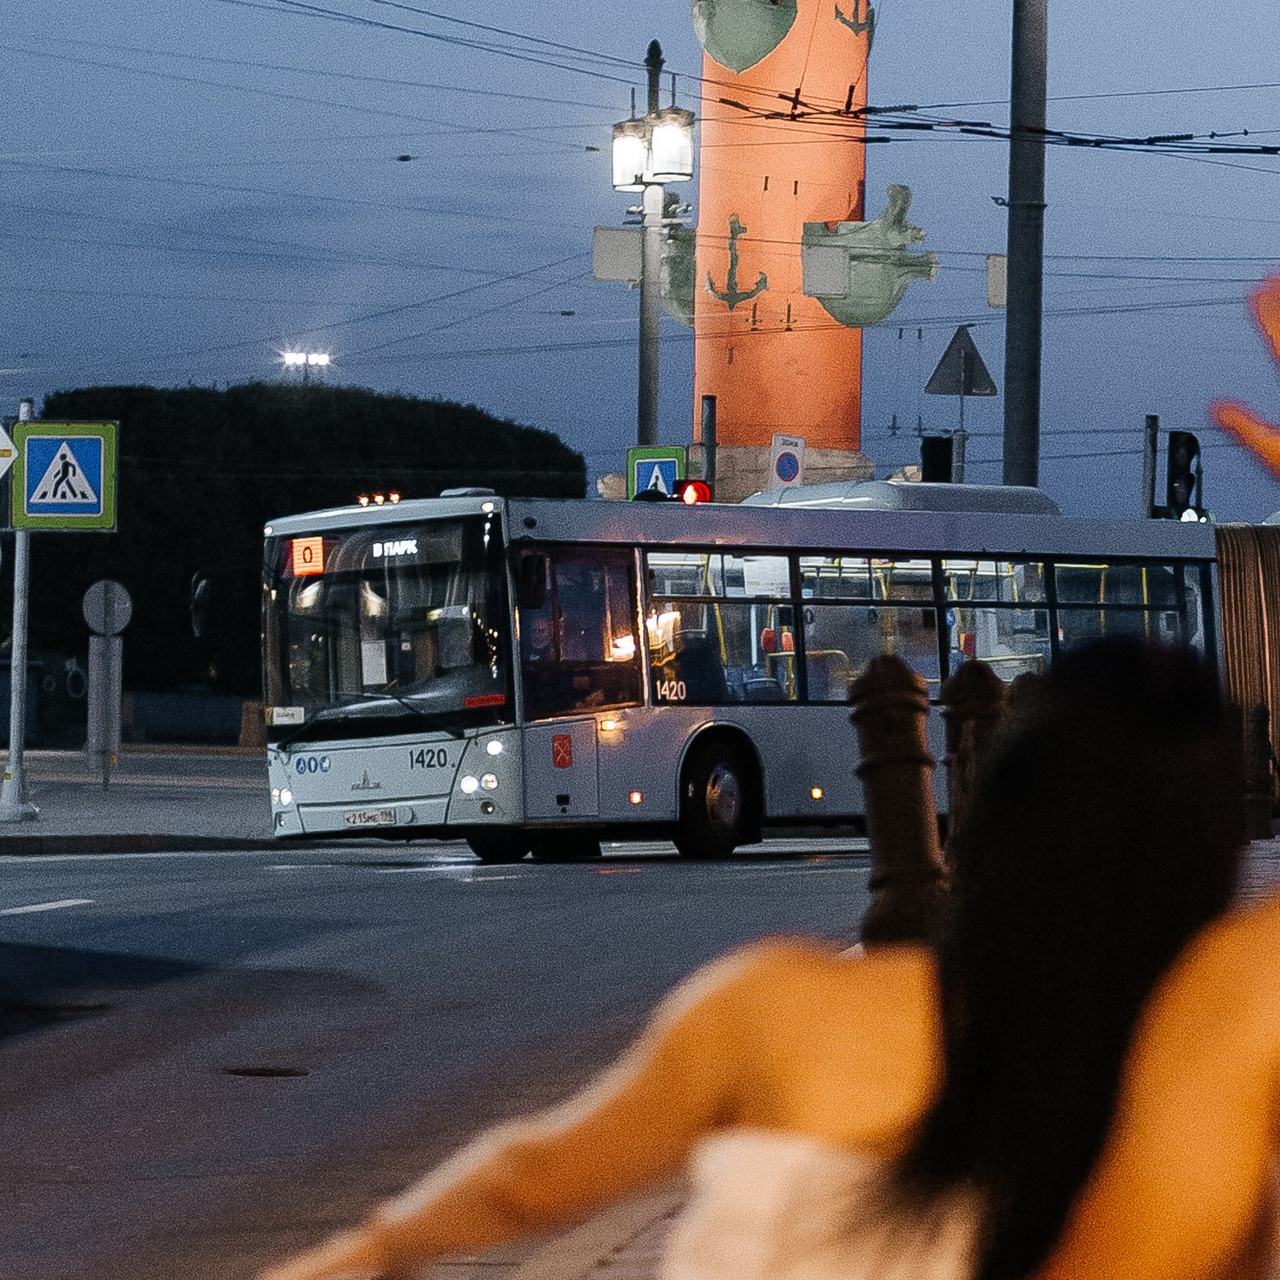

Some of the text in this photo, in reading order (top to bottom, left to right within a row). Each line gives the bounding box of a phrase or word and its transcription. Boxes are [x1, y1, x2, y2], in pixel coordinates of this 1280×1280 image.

[372, 539, 419, 558] В ПАРК
[655, 679, 687, 701] 1420
[408, 747, 449, 770] 1420
